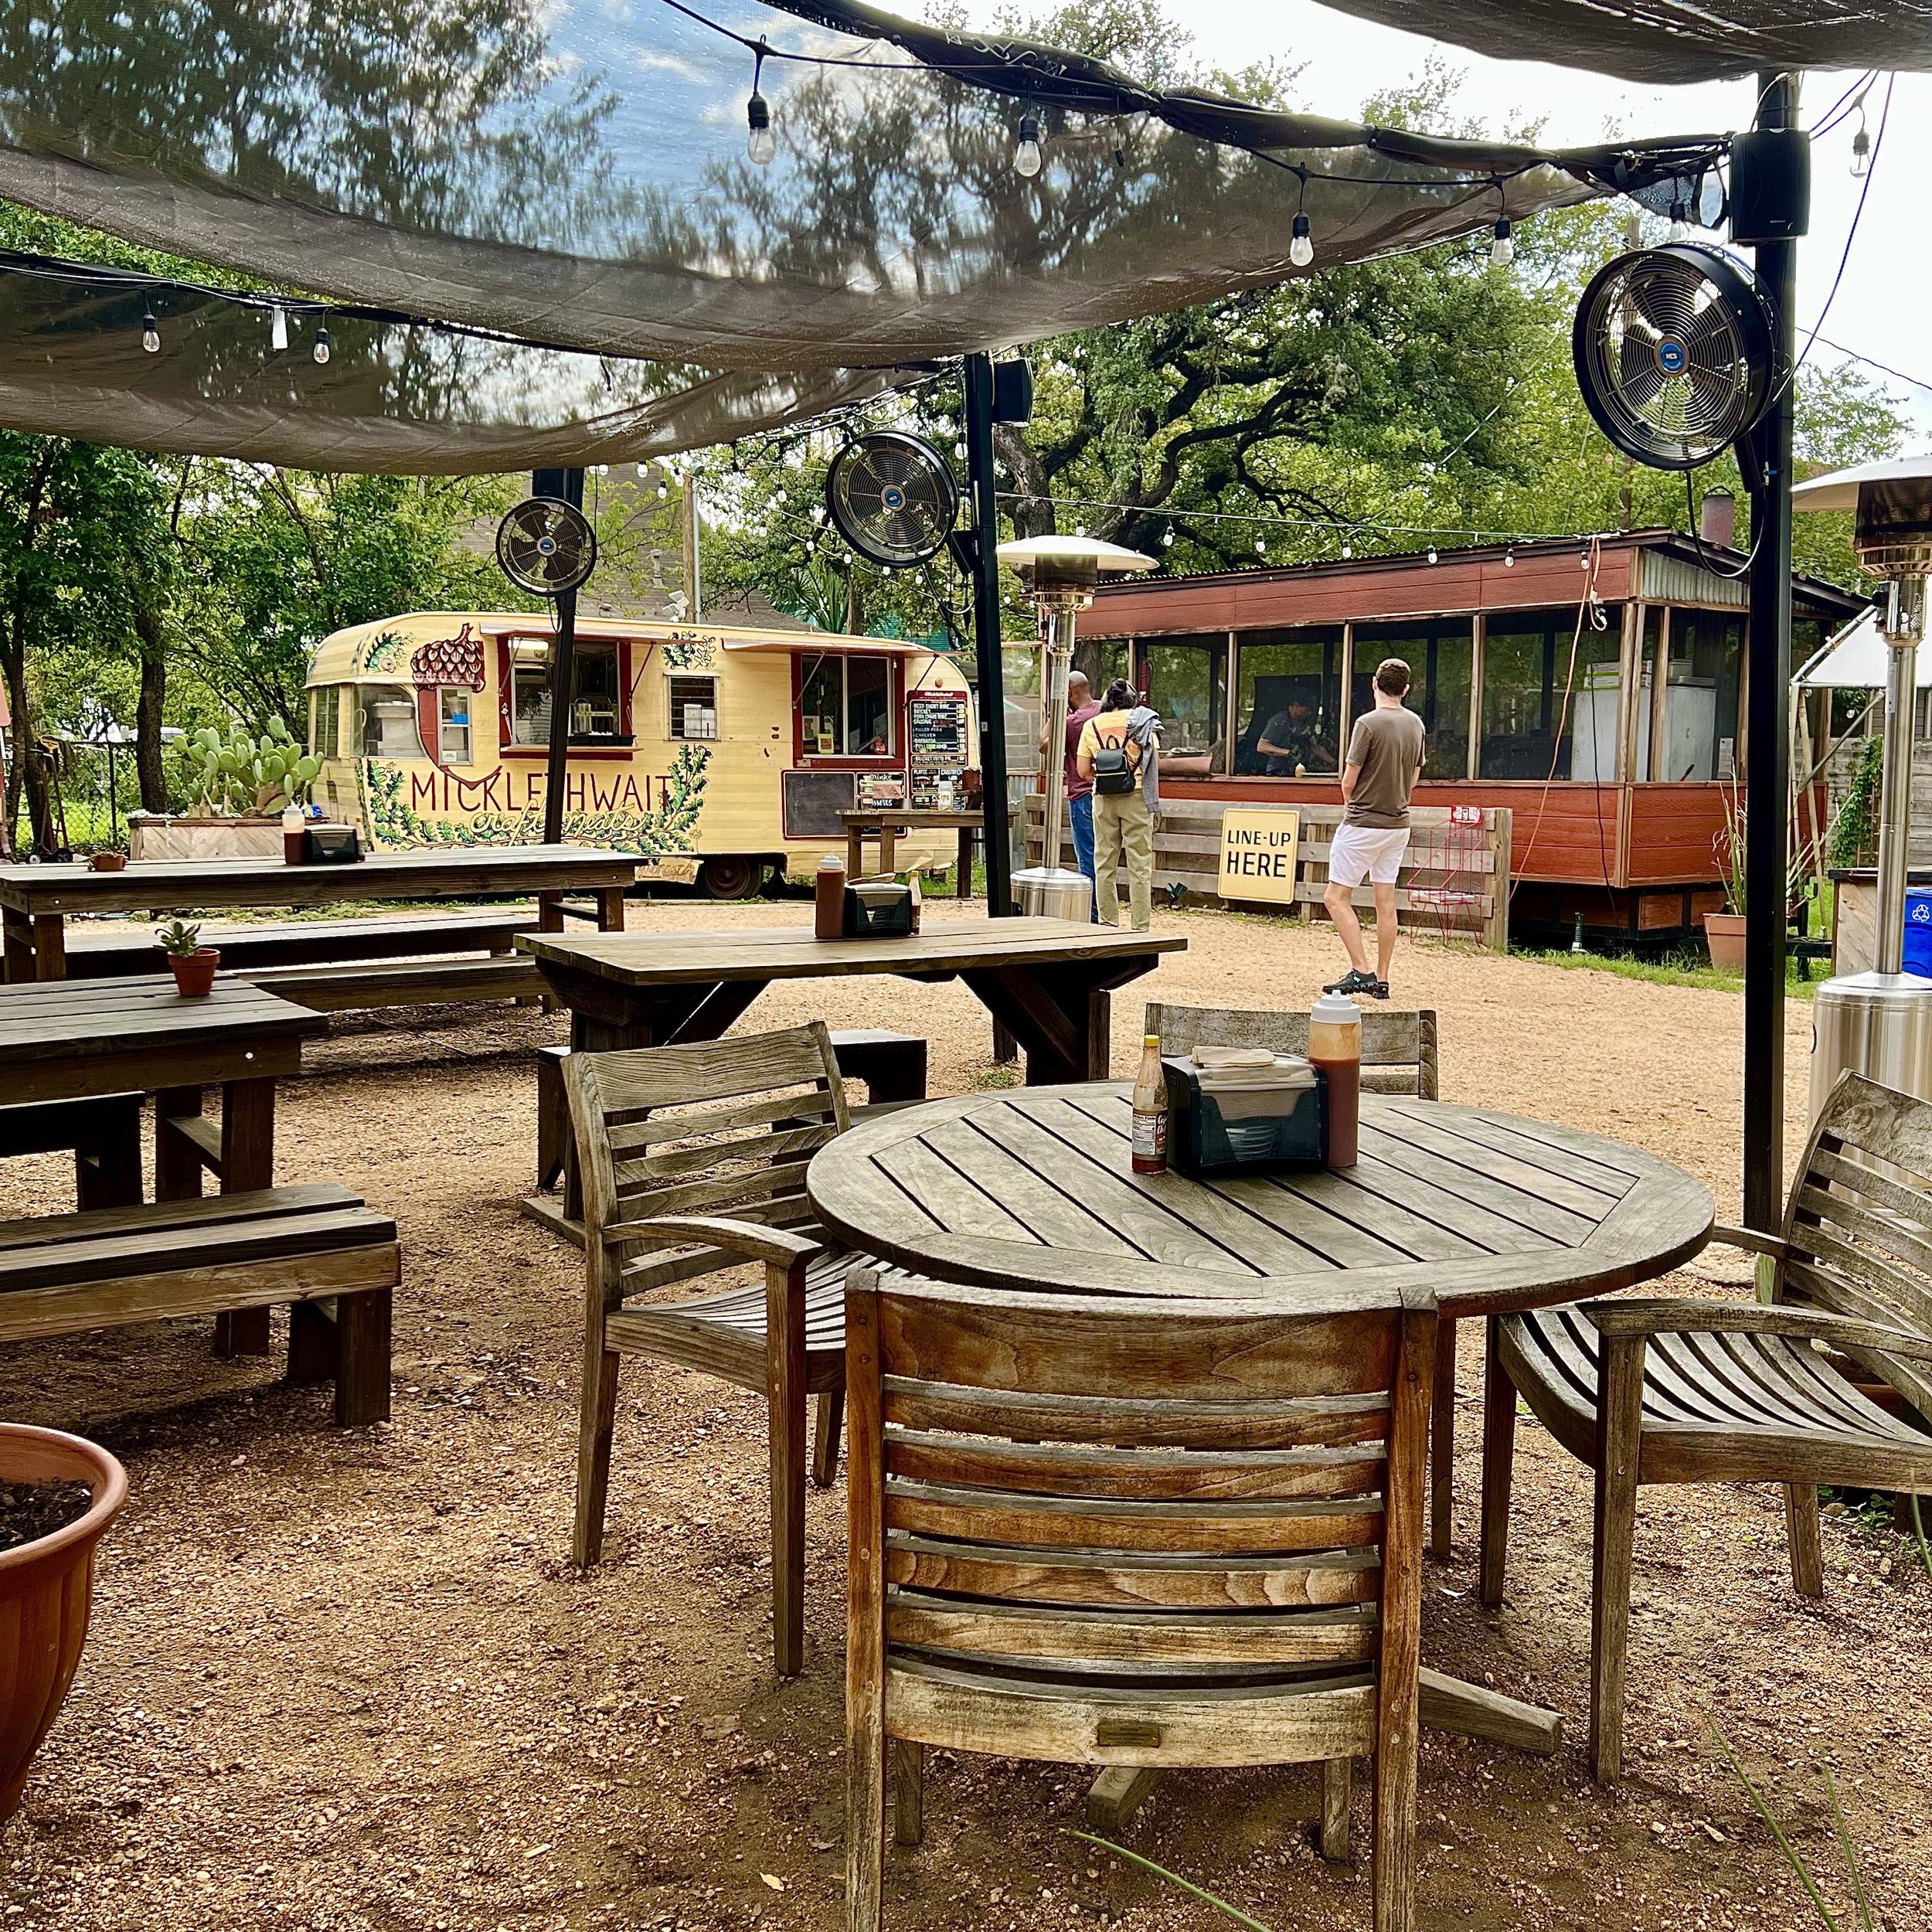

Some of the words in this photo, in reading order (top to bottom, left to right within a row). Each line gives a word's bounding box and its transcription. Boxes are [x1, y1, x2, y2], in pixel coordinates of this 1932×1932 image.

[412, 770, 674, 812] MICKLEHWAIT
[1227, 830, 1291, 847] LINE-UP
[1226, 851, 1287, 878] HERE
